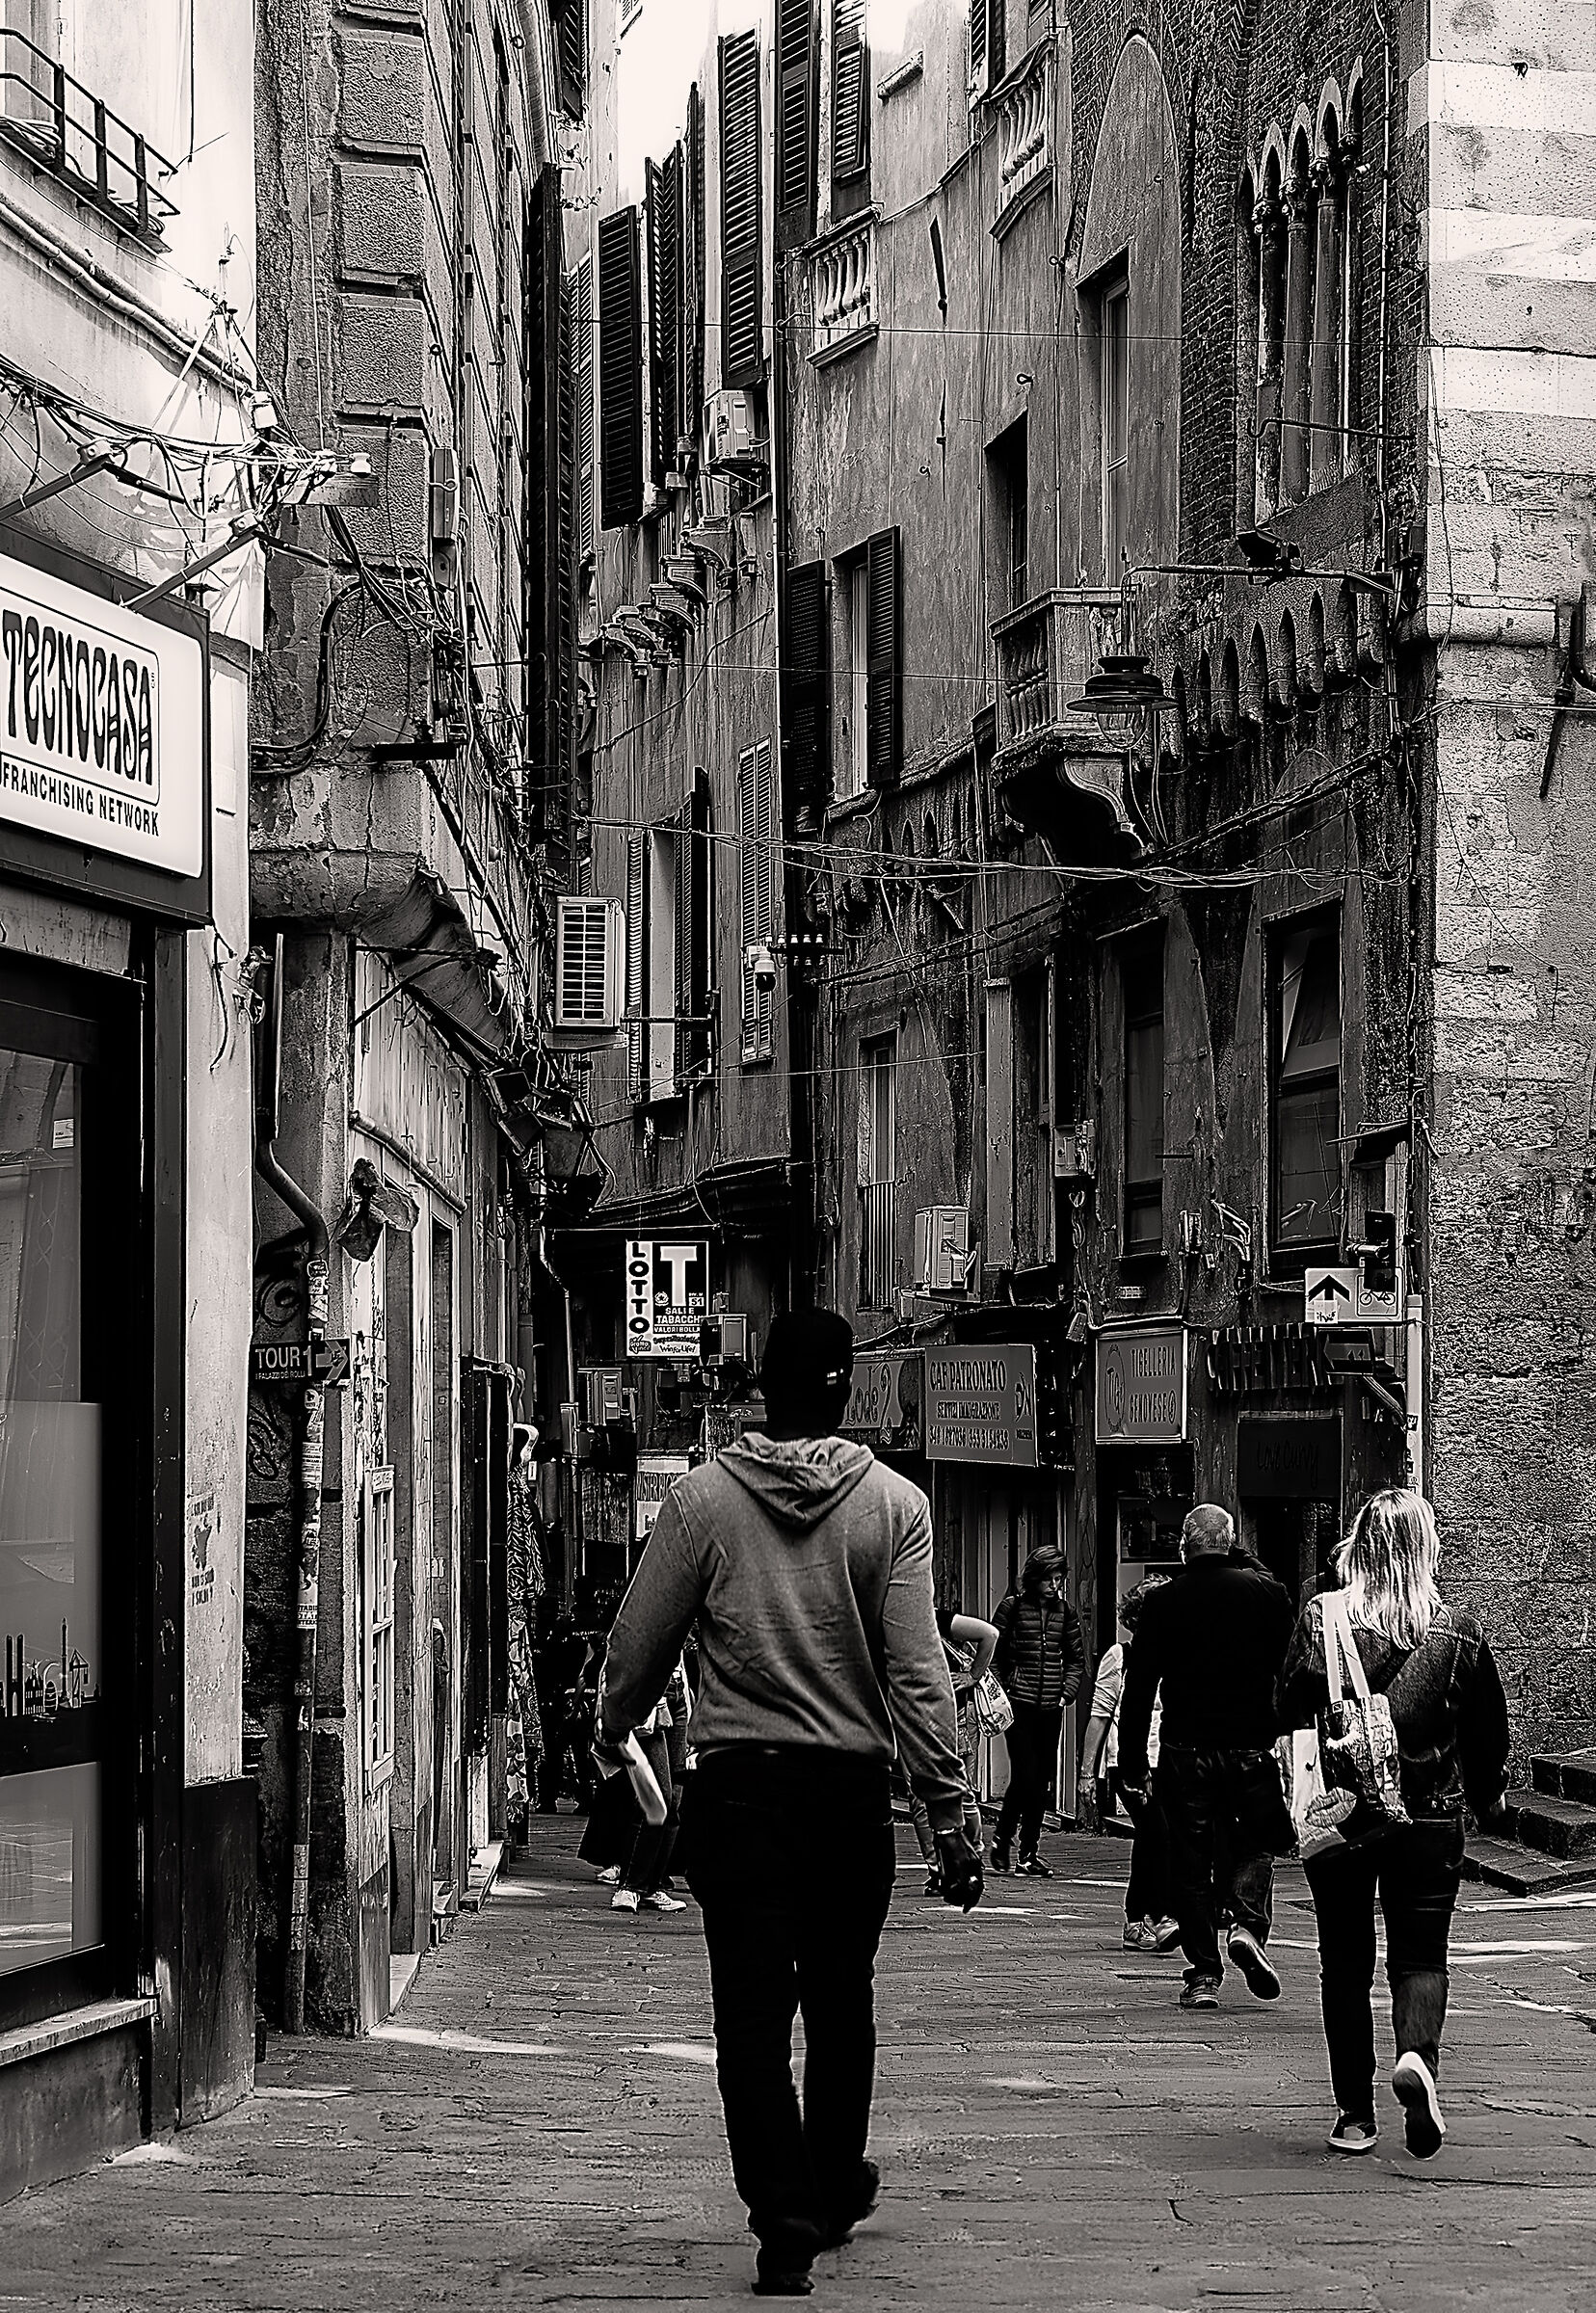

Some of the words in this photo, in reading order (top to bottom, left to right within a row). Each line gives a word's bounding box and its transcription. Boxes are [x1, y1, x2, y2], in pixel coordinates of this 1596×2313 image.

[2, 609, 152, 785] TECNOCASA
[3, 762, 93, 815] FRANCHISING
[99, 793, 159, 837] NETWORK
[628, 1241, 650, 1334] LOTTO
[660, 1246, 697, 1307] T
[655, 1316, 700, 1324] TABACCH
[254, 1346, 300, 1369] TOUR
[303, 1345, 312, 1376] 1
[930, 1360, 947, 1391] CAF
[948, 1360, 1007, 1391] PATRONATO
